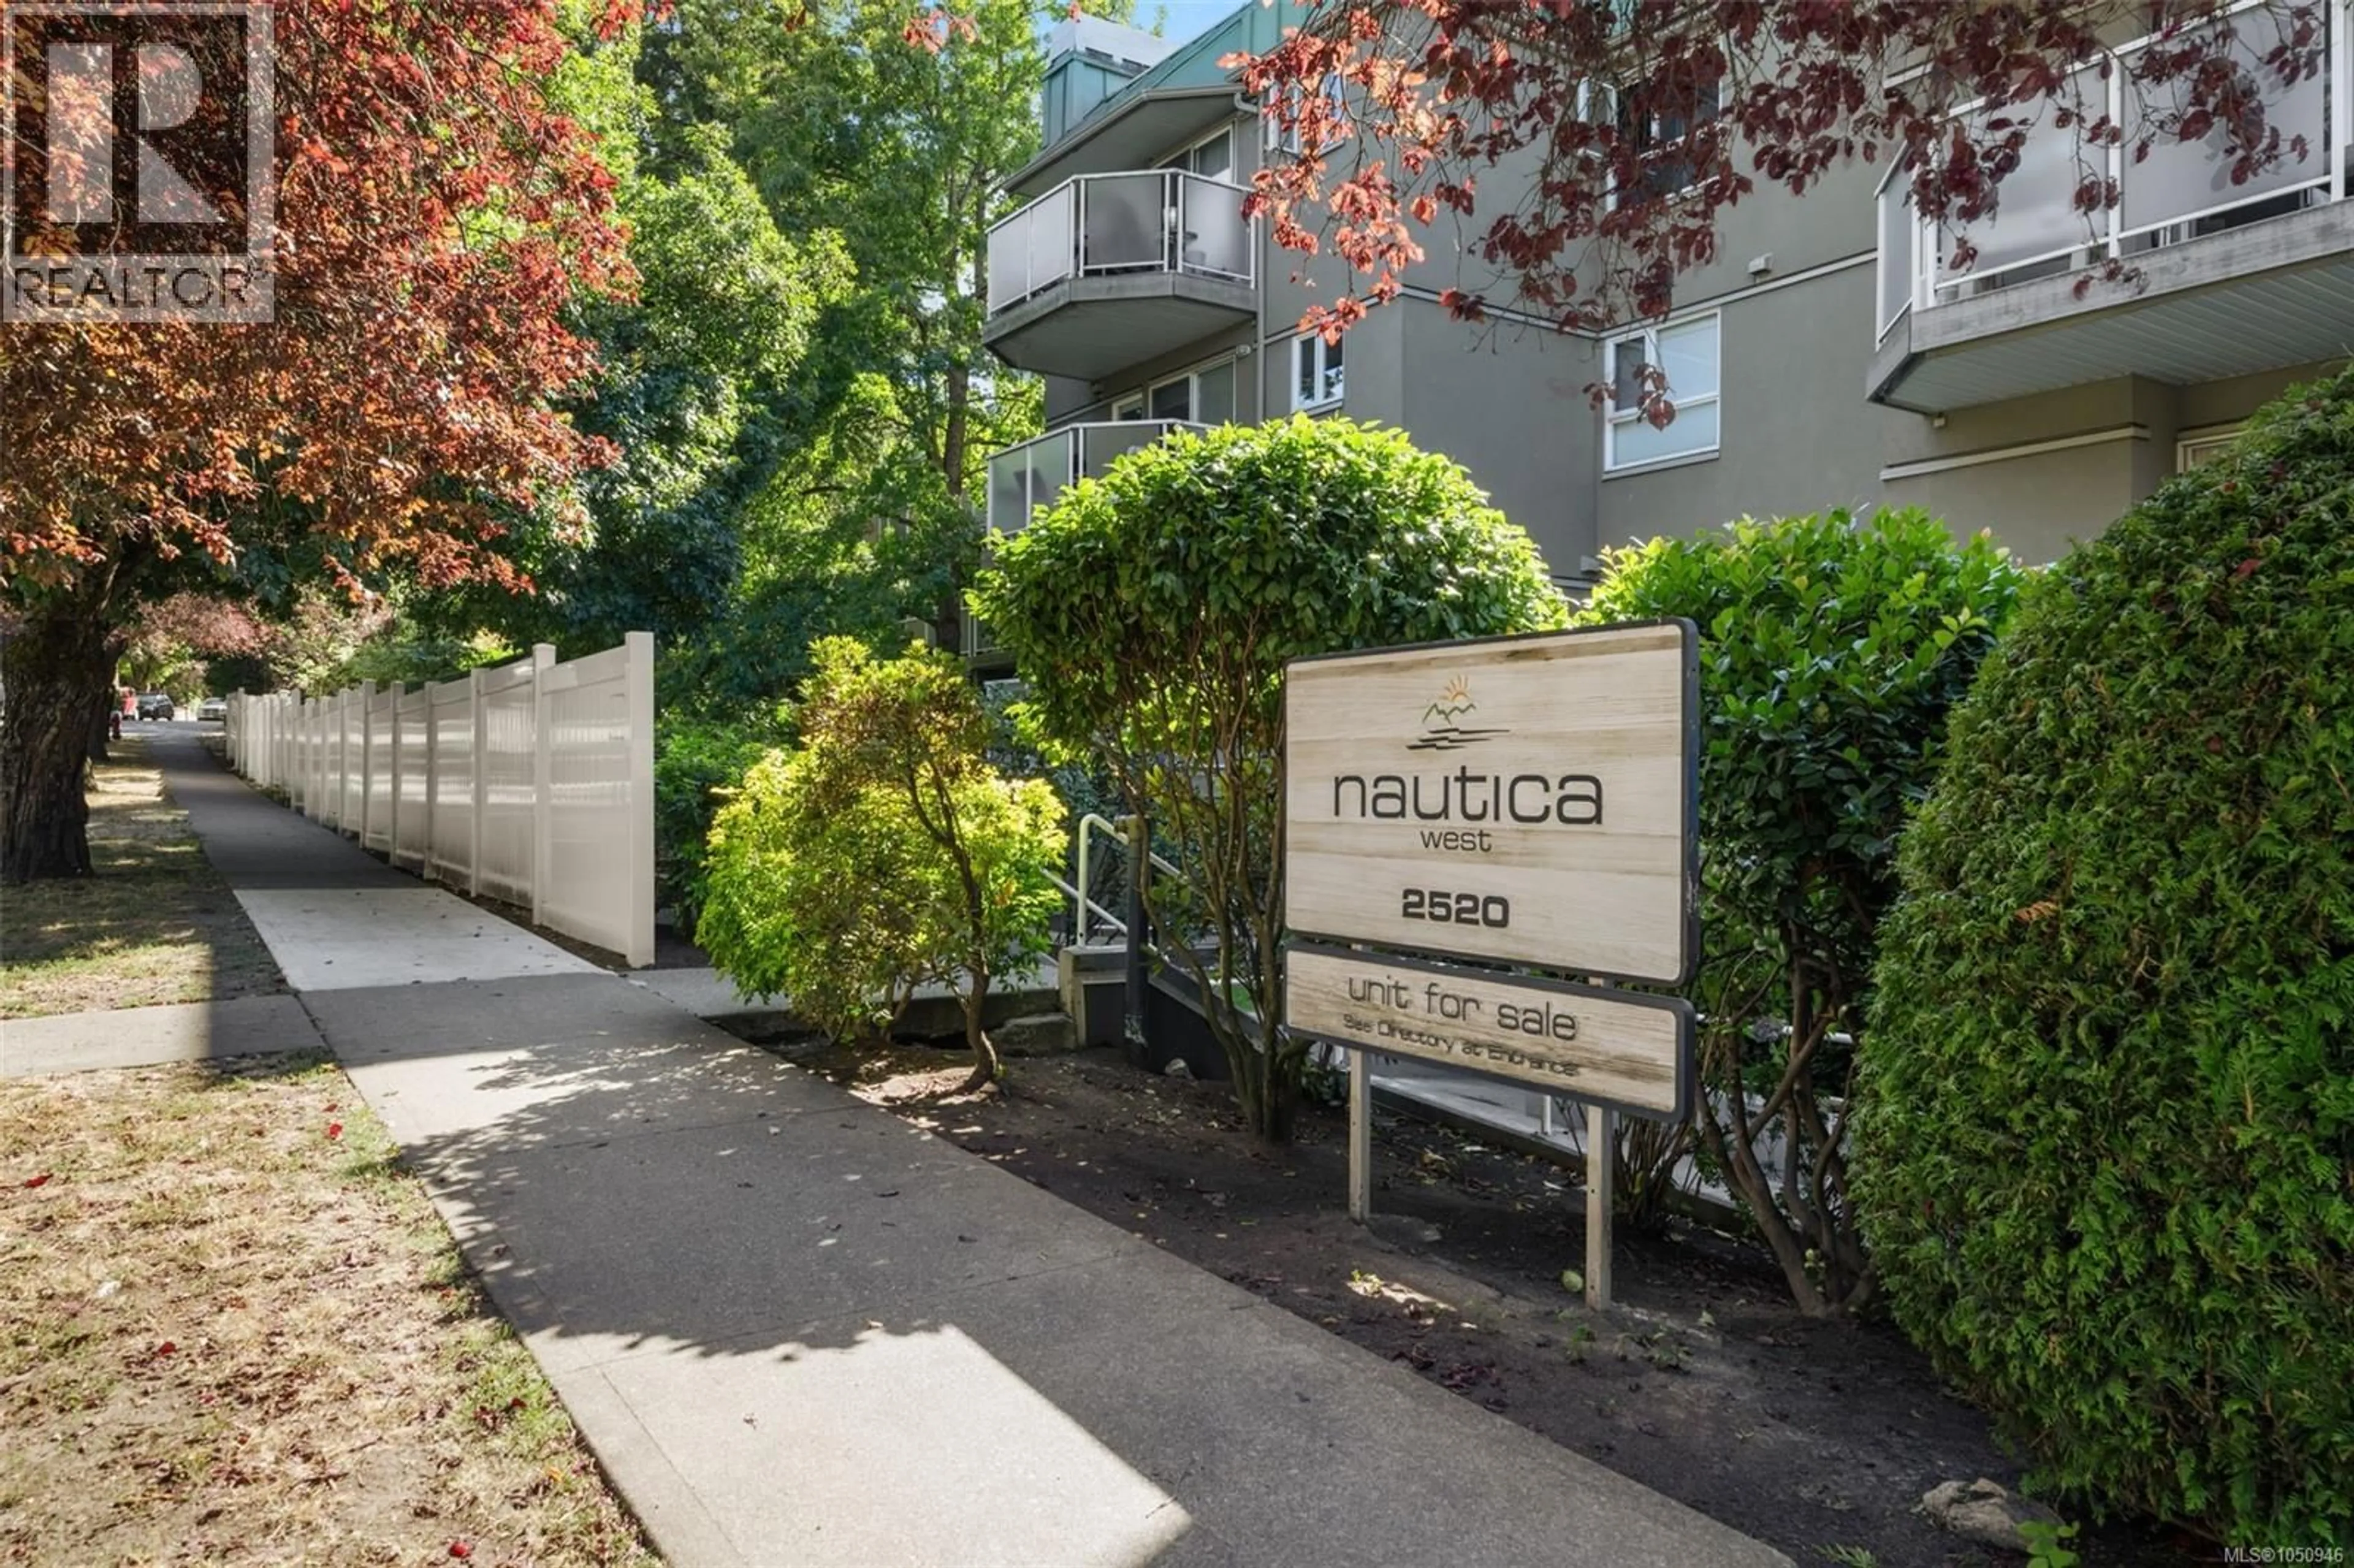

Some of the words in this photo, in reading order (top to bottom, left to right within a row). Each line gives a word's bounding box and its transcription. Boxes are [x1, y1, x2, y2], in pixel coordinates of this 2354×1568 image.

[1334, 766, 1604, 825] nautica
[1420, 829, 1492, 853] west
[1402, 888, 1510, 928] 2520
[1349, 975, 1409, 1009] unit
[1425, 981, 1480, 1021] for
[1497, 1001, 1576, 1040] sale
[1377, 1020, 1455, 1053] Directory
[1463, 1040, 1482, 1057] at
